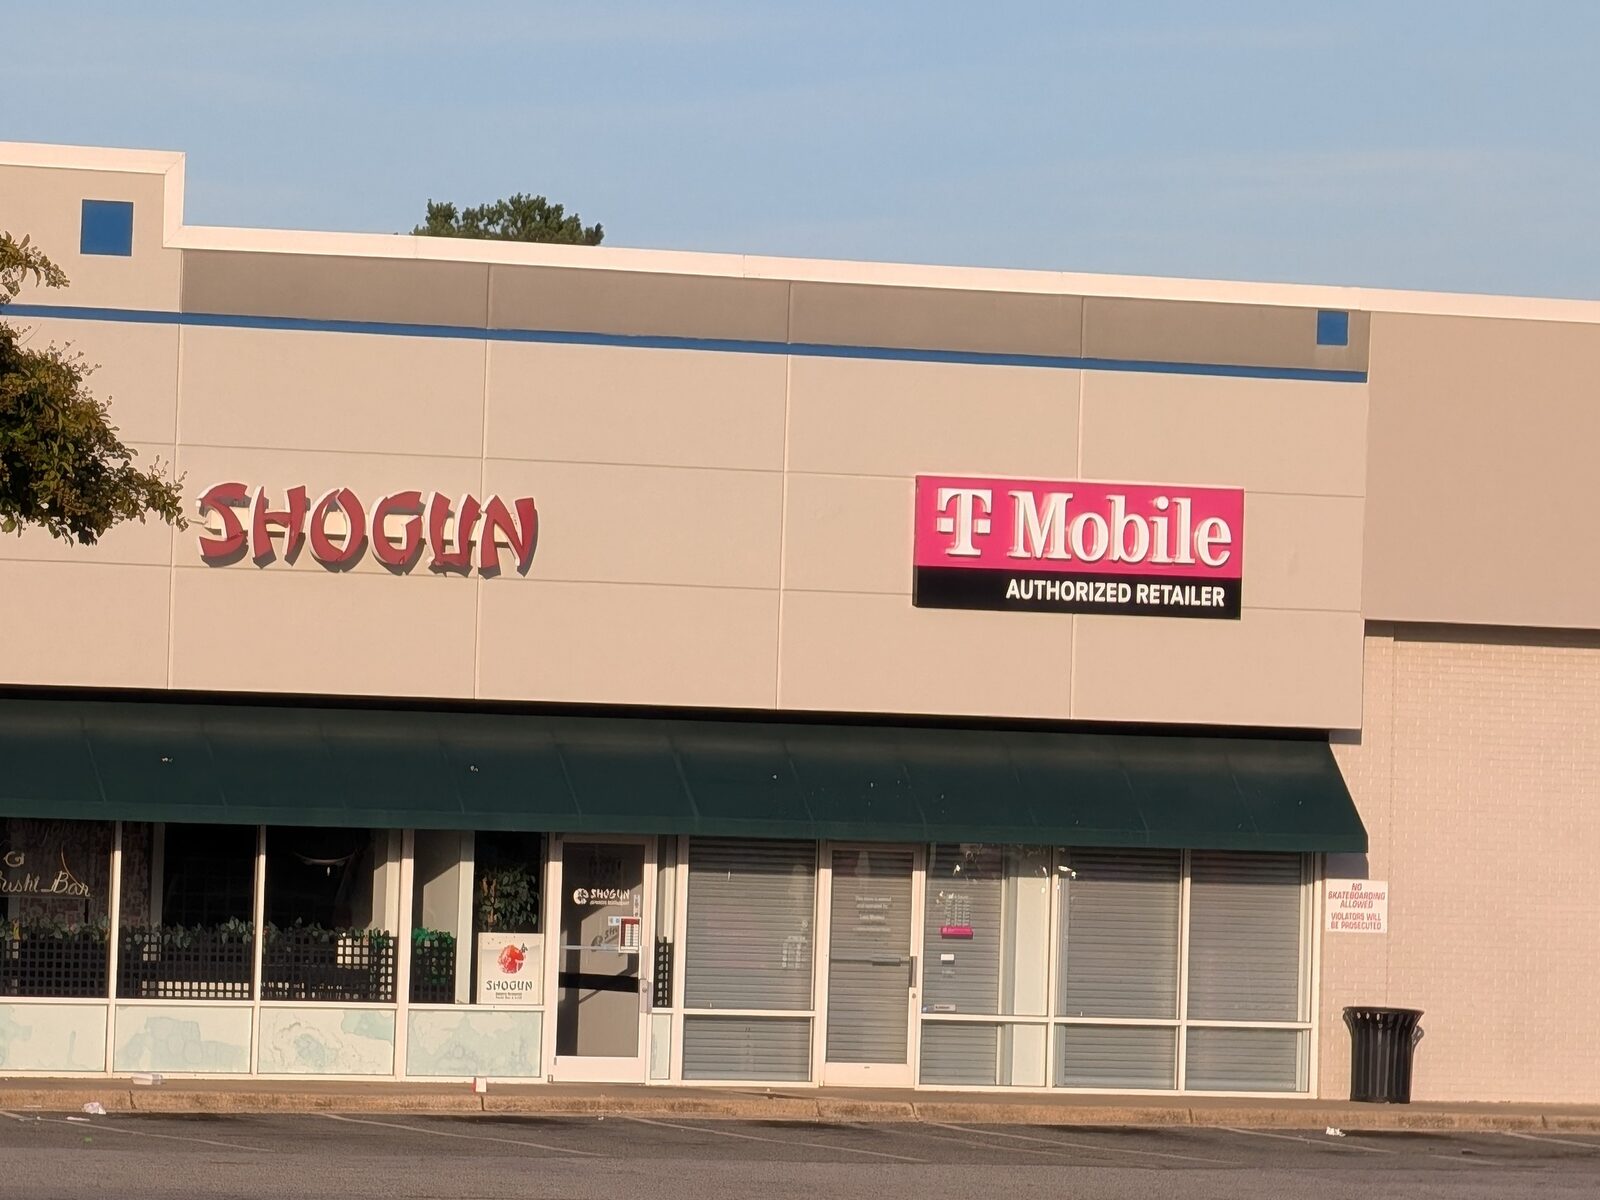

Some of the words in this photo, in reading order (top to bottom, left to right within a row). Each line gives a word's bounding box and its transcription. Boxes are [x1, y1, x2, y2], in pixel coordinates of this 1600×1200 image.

[196, 482, 538, 574] SHOGUN
[1007, 490, 1233, 567] Mobile
[1006, 578, 1132, 603] AUTHORIZED
[1136, 583, 1226, 607] RETAILER
[0, 870, 40, 893] ushi
[46, 870, 91, 897] Bar
[1351, 883, 1363, 891] NO
[590, 888, 630, 901] SHOGUN
[1328, 891, 1386, 900] SKATEBOARDING
[1340, 900, 1374, 909] ALLOWED
[1331, 912, 1365, 921] VIOLATORS
[1366, 913, 1382, 921] WILL
[1331, 921, 1339, 929] BE
[486, 980, 533, 991] SHOGUN
